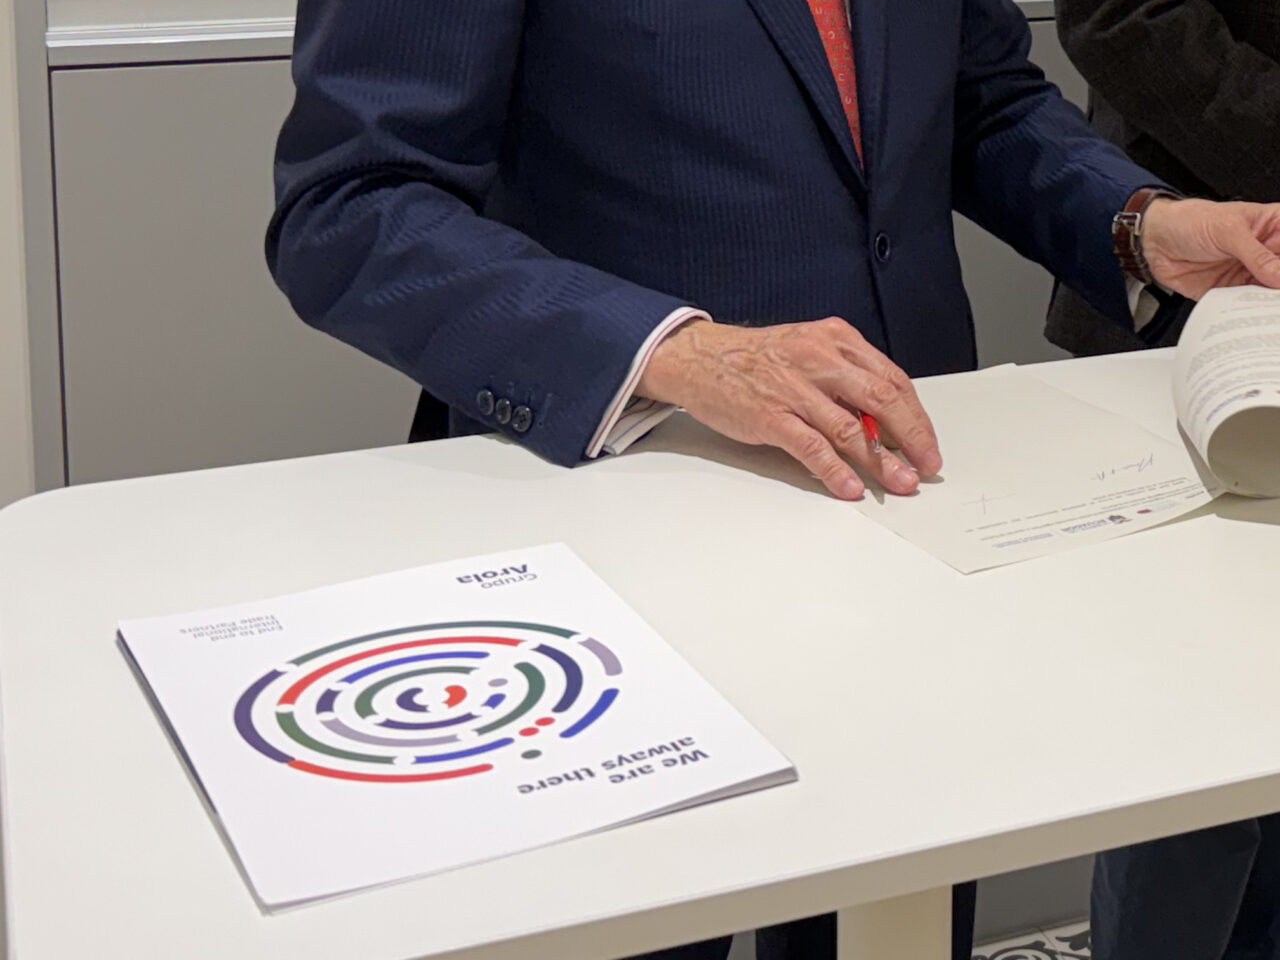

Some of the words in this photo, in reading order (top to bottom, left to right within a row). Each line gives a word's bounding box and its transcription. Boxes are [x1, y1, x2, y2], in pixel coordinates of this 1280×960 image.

[456, 563, 528, 584] Arola
[481, 573, 538, 589] Grupo
[179, 621, 237, 634] Partners
[239, 614, 278, 625] Trade
[193, 620, 281, 639] International
[210, 633, 236, 642] end
[258, 625, 283, 634] End
[600, 736, 695, 771] always
[661, 748, 710, 768] We
[517, 767, 596, 794] there
[608, 764, 655, 784] are
